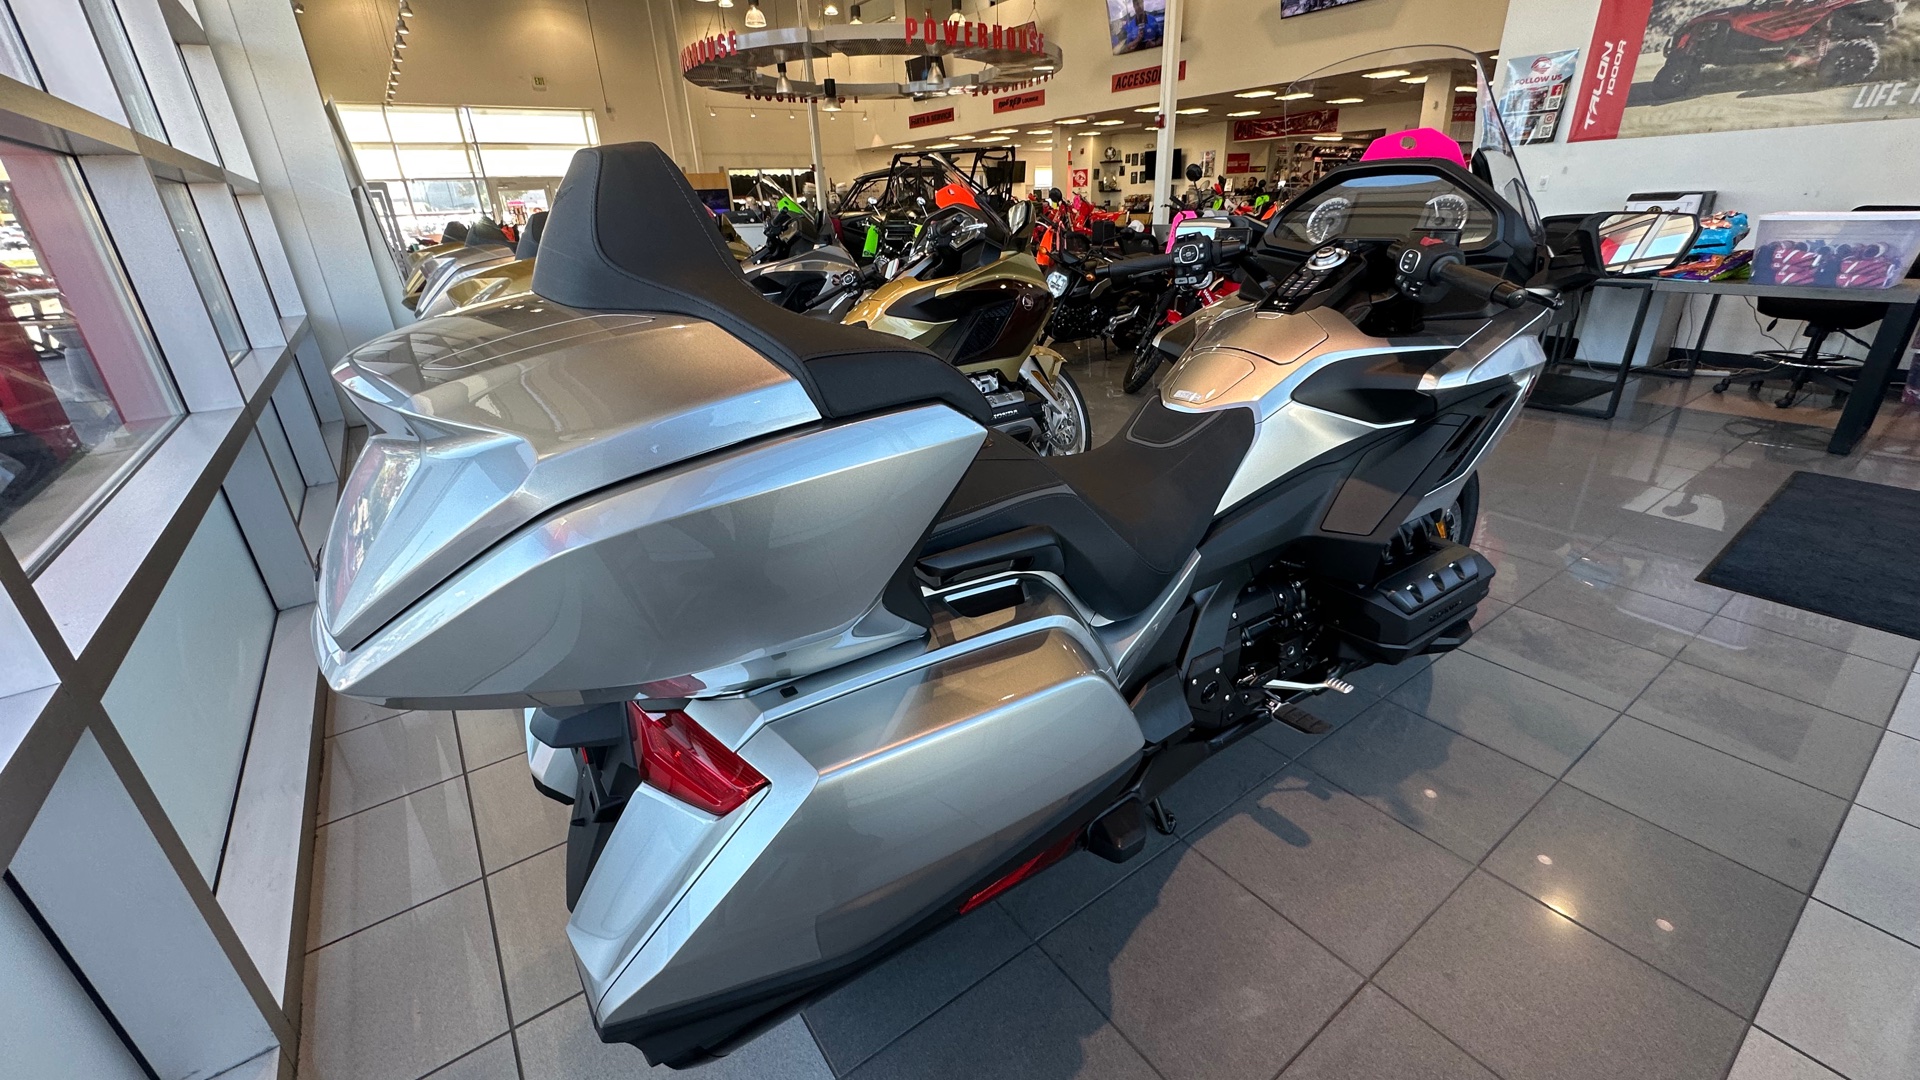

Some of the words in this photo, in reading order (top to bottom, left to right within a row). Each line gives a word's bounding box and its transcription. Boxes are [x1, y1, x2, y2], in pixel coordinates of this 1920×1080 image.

[904, 16, 1046, 57] POWERHOUSE
[1115, 68, 1161, 90] ACCESSO
[1515, 75, 1549, 85] FOLLOW
[1551, 73, 1562, 81] US
[1606, 40, 1627, 95] 1000R
[1584, 41, 1613, 130] TALON
[1852, 82, 1907, 109] LIFE
